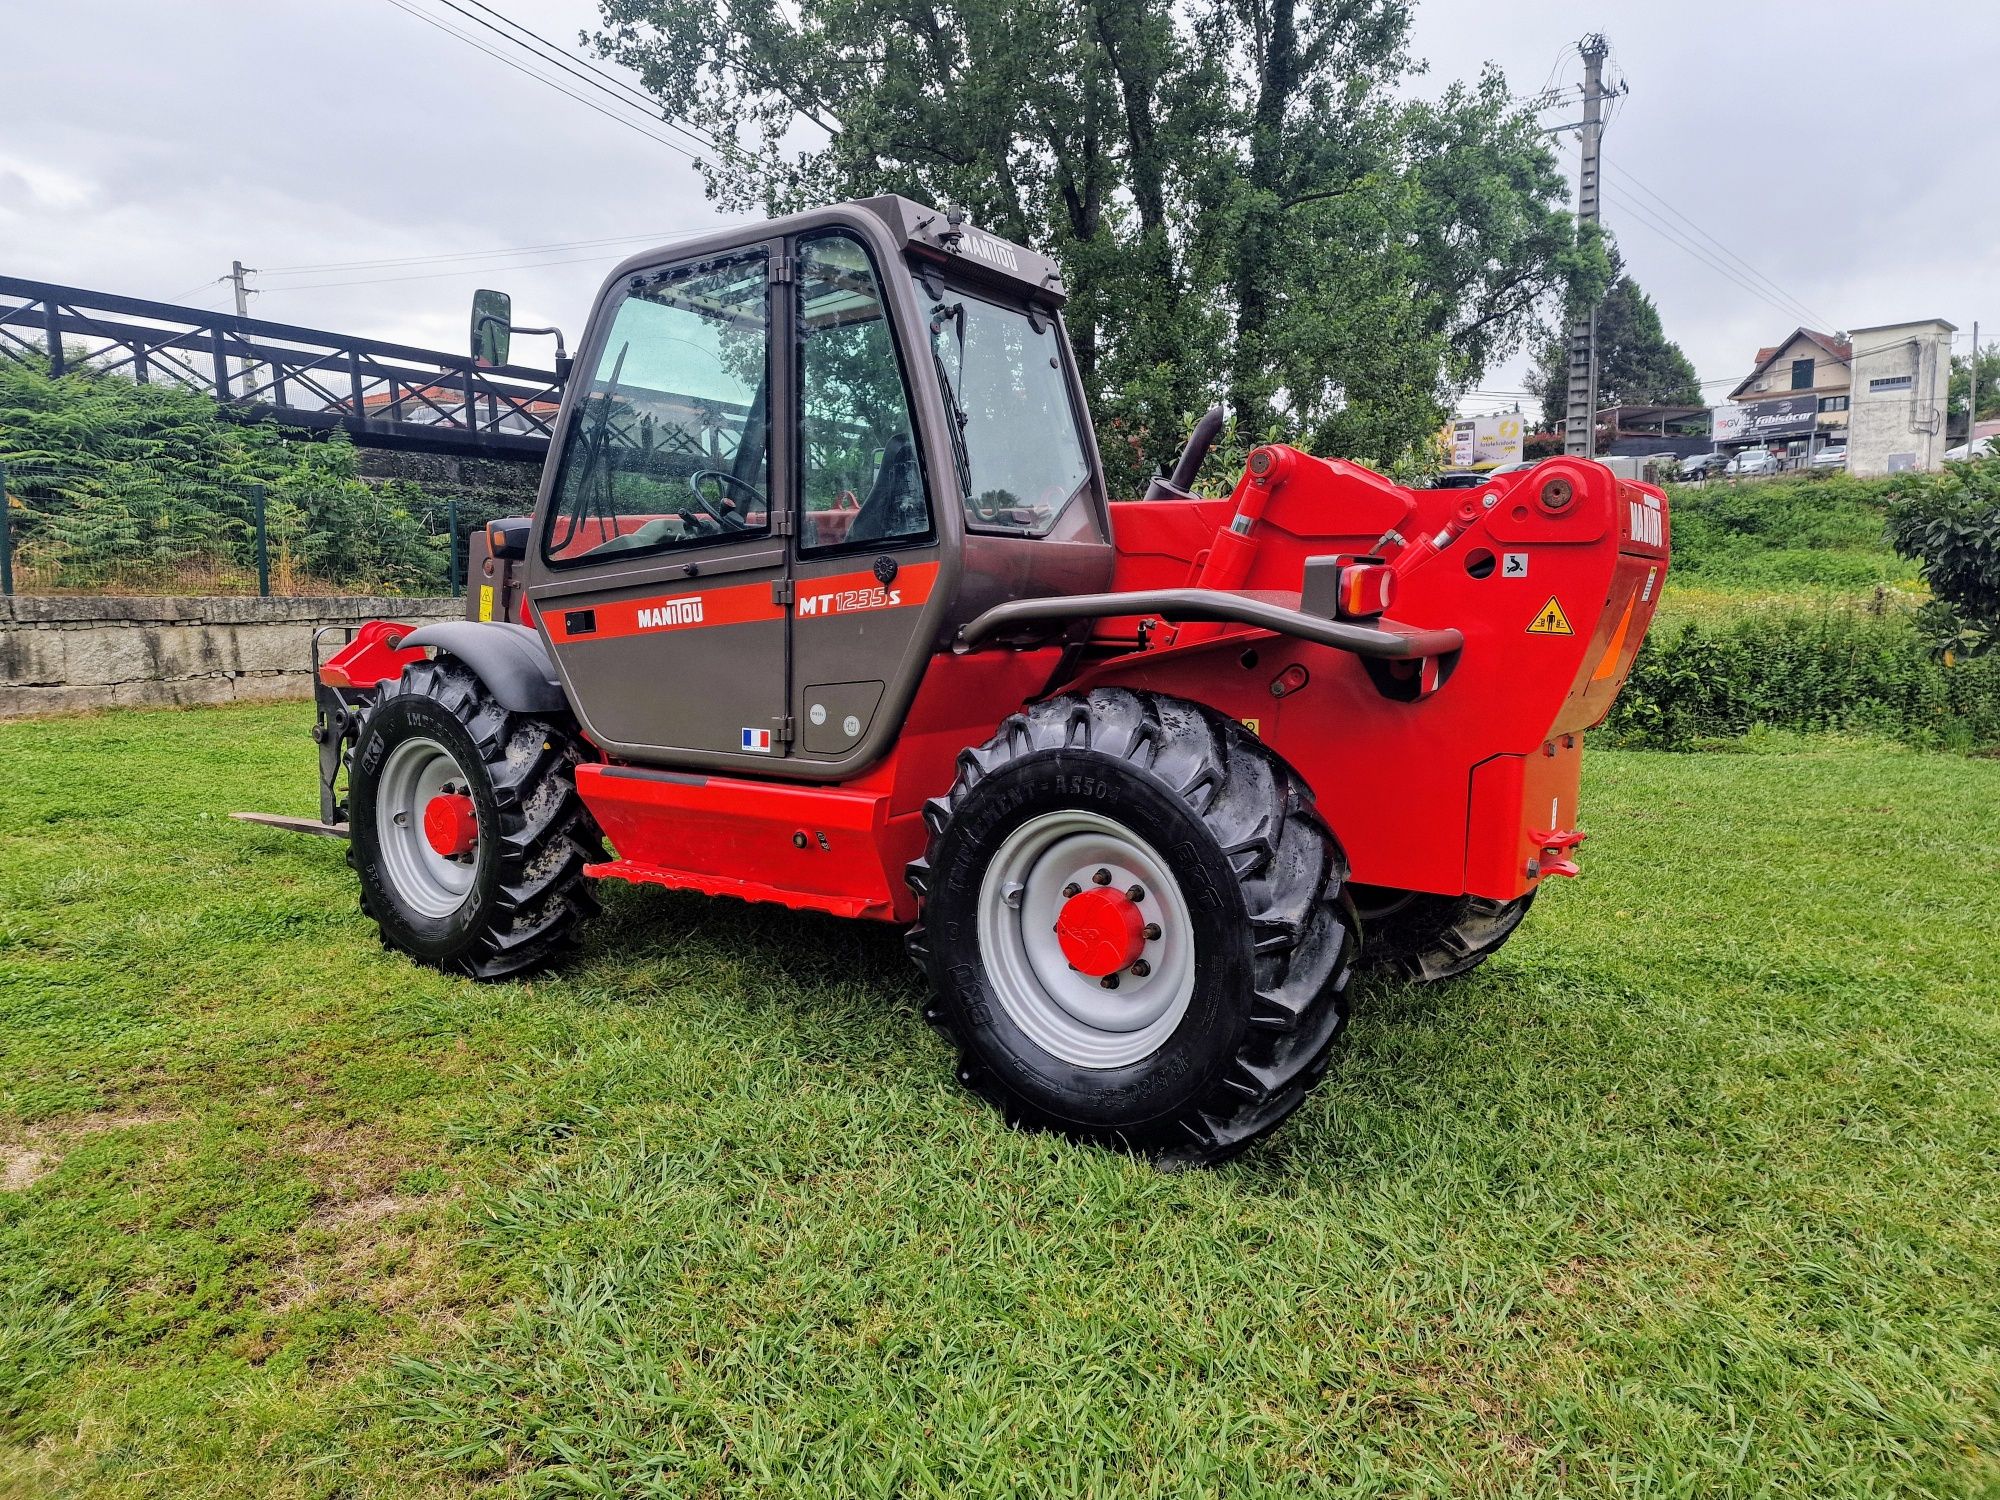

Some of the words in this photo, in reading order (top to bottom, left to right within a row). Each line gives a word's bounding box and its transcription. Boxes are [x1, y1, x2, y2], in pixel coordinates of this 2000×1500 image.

[959, 233, 1019, 272] MANITOU
[1630, 494, 1663, 548] MANITOU
[637, 596, 704, 629] MANITOU
